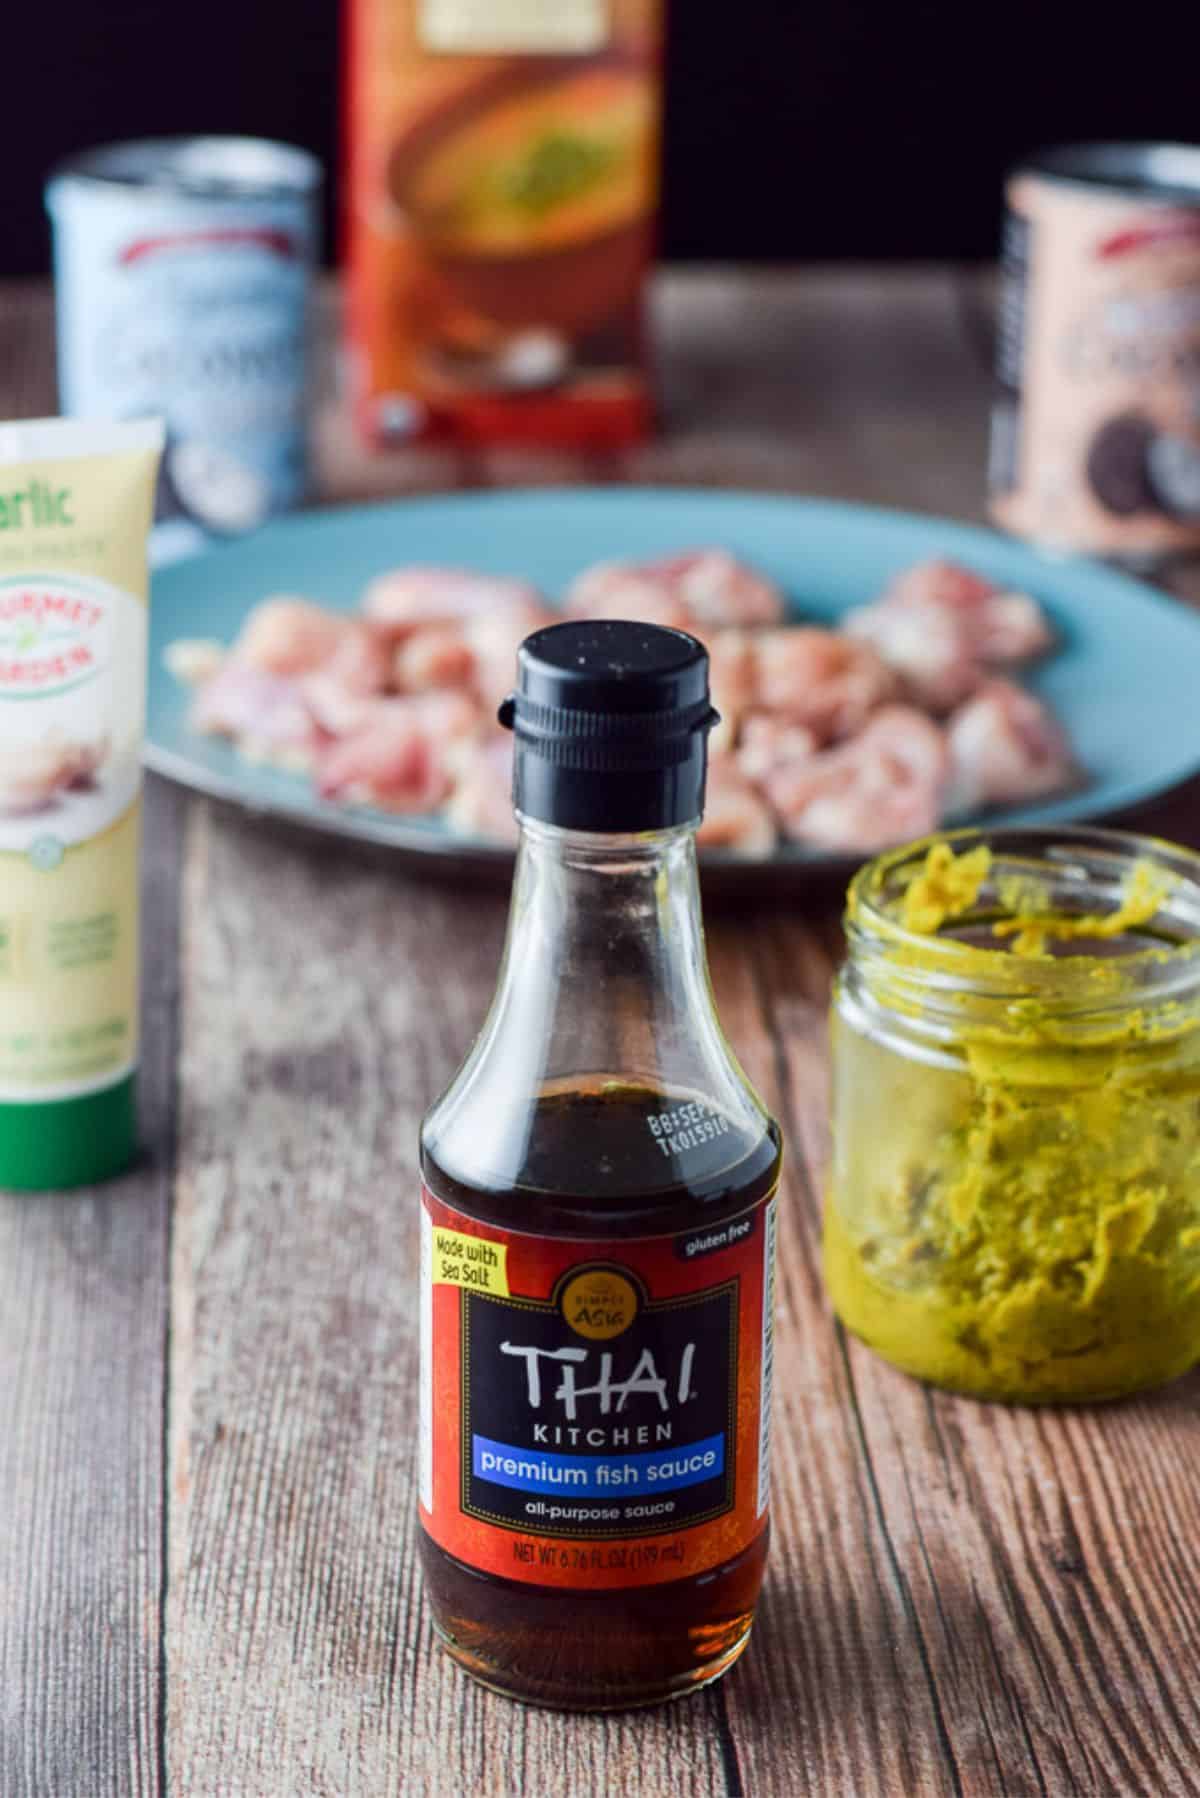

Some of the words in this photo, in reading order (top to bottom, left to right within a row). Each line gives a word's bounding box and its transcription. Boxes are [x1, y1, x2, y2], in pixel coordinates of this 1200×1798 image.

[436, 1235, 463, 1258] Made
[466, 1243, 498, 1267] with
[686, 1232, 727, 1256] gluten
[727, 1221, 751, 1244] free
[441, 1260, 460, 1280] Sea
[462, 1263, 489, 1287] Salt
[500, 1343, 697, 1421] THAI
[533, 1422, 673, 1447] KITCHEN
[481, 1451, 588, 1486] premium
[595, 1464, 639, 1485] fish
[647, 1450, 716, 1482] sauce
[525, 1501, 620, 1521] all-purpose
[625, 1501, 675, 1519] sauce
[513, 1541, 535, 1563] NET
[538, 1543, 557, 1567] WT
